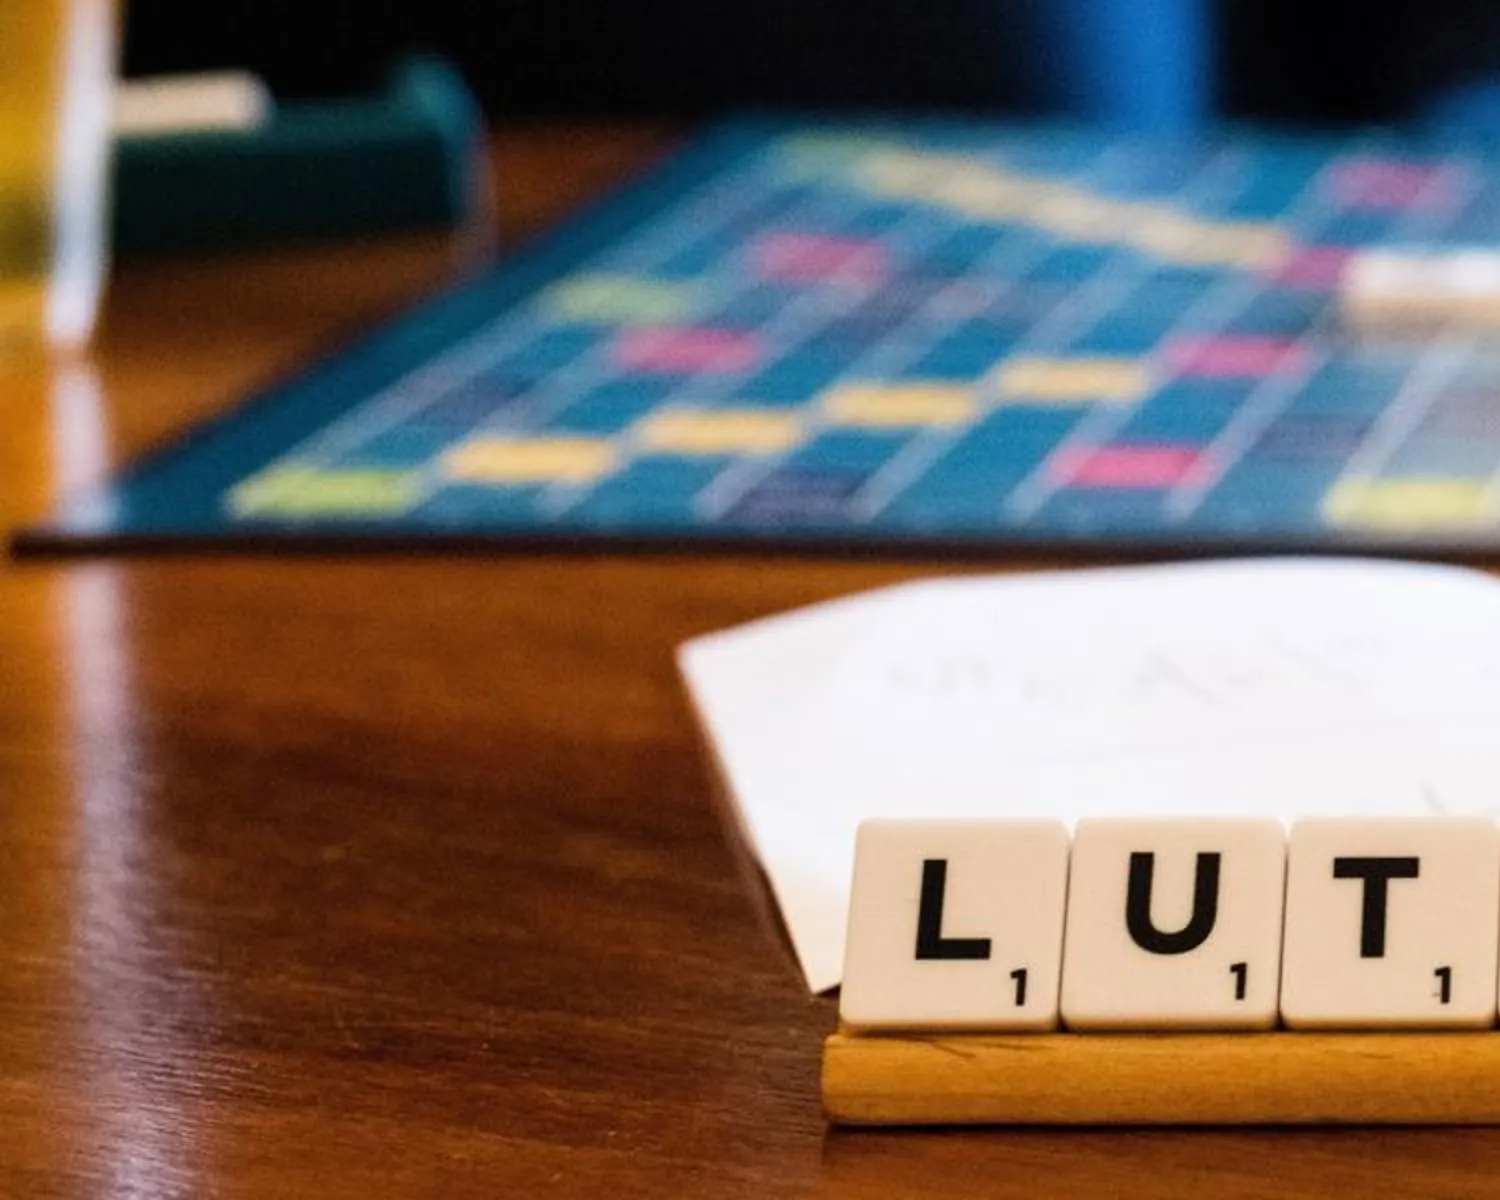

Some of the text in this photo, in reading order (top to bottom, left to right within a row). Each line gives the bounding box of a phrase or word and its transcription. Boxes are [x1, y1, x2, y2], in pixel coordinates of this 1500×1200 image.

[1011, 968, 1028, 1007] 1
[1230, 962, 1248, 1001] 1
[1435, 966, 1452, 1004] 1
